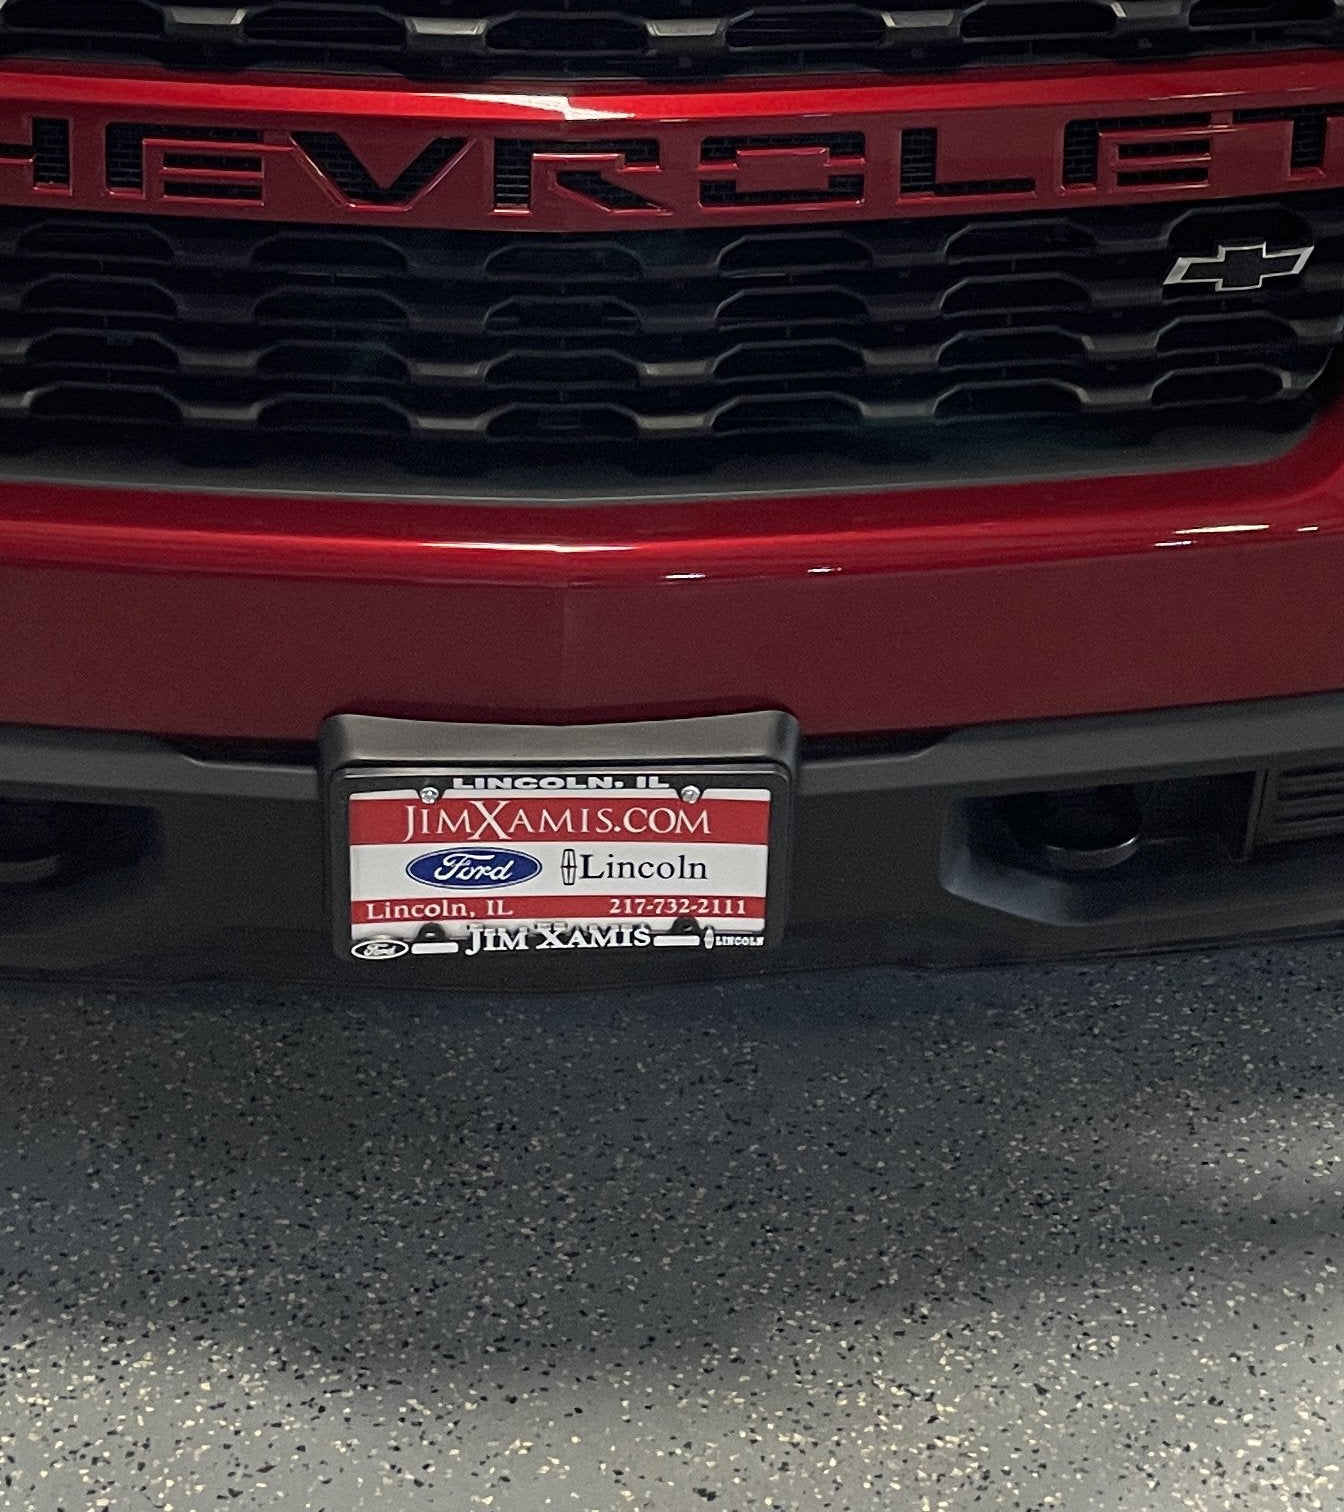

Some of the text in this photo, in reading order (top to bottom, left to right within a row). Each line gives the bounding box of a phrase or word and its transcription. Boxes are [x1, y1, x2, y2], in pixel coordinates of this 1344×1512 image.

[636, 776, 670, 789] IL
[402, 800, 712, 841] JIMXAMIS.COM
[433, 852, 514, 884] Ford
[579, 853, 708, 880] Lincoln
[366, 899, 514, 920] Lincoln, IL
[609, 899, 746, 915] 217-732-2111
[465, 922, 651, 956] JIM XAMIS
[715, 936, 764, 947] LINCOLN
